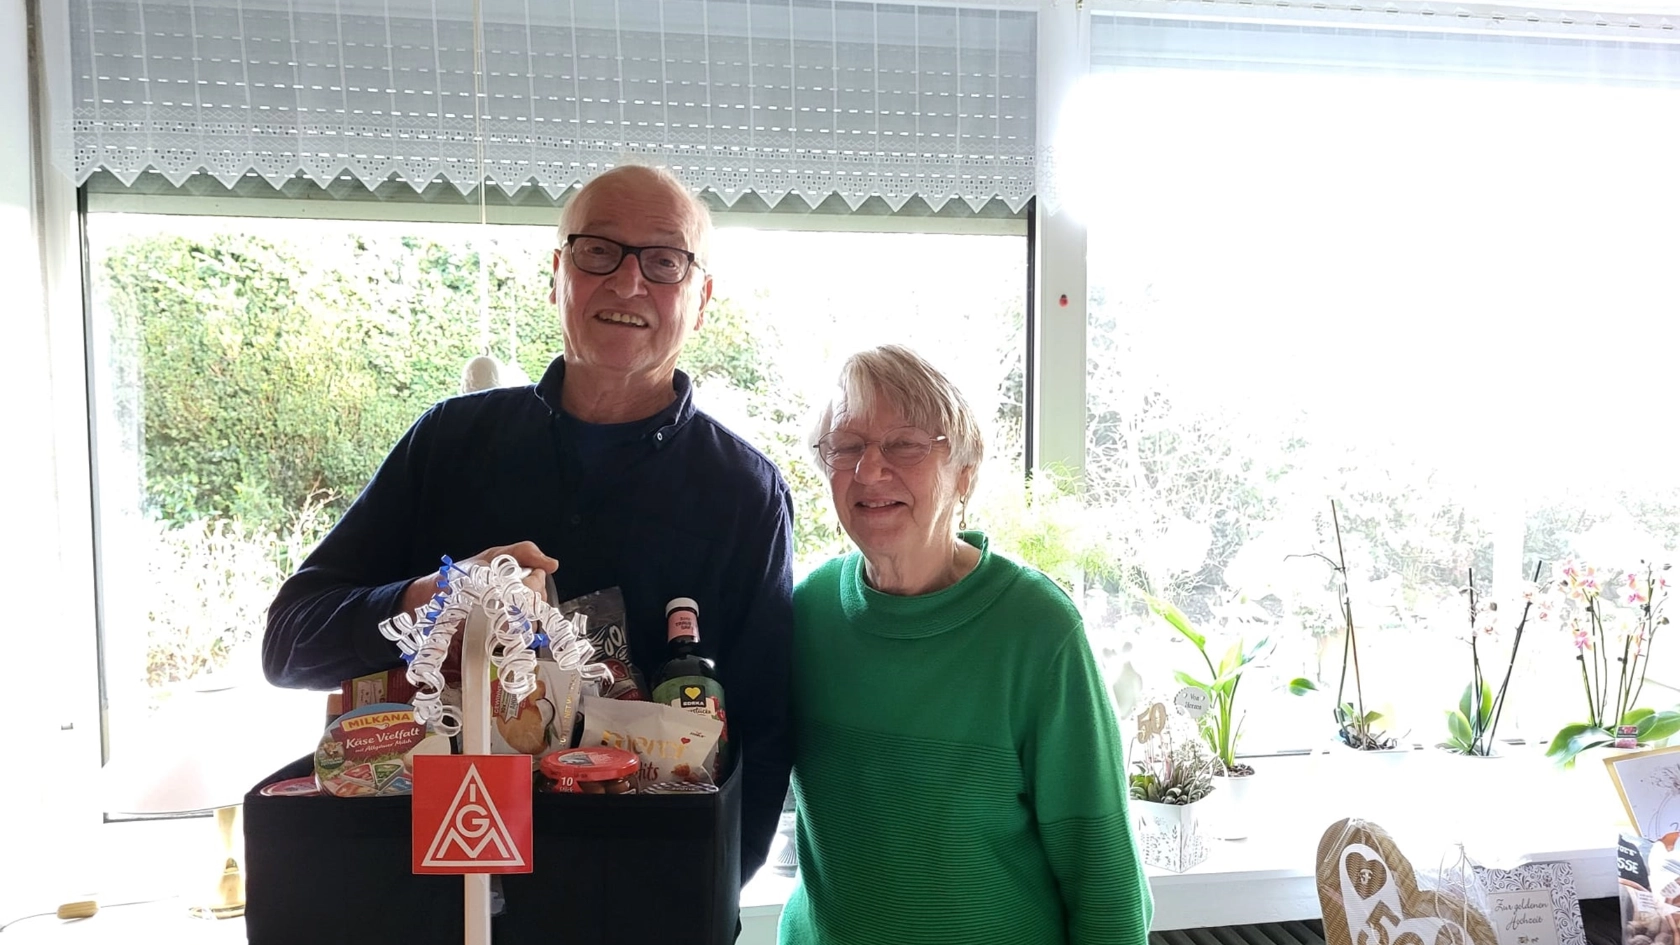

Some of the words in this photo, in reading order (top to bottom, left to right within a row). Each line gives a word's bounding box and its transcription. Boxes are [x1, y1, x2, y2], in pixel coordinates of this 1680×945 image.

[1190, 693, 1200, 701] Von
[348, 713, 410, 728] MILKANA
[1137, 702, 1166, 743] 50
[346, 737, 375, 749] Käse
[376, 727, 420, 743] Vielfalt
[394, 738, 412, 746] Milch
[561, 776, 573, 787] 10
[1617, 857, 1639, 875] SSE
[1494, 898, 1513, 912] Zur
[1513, 897, 1548, 914] goldenen
[1505, 912, 1543, 930] Hochzeit
